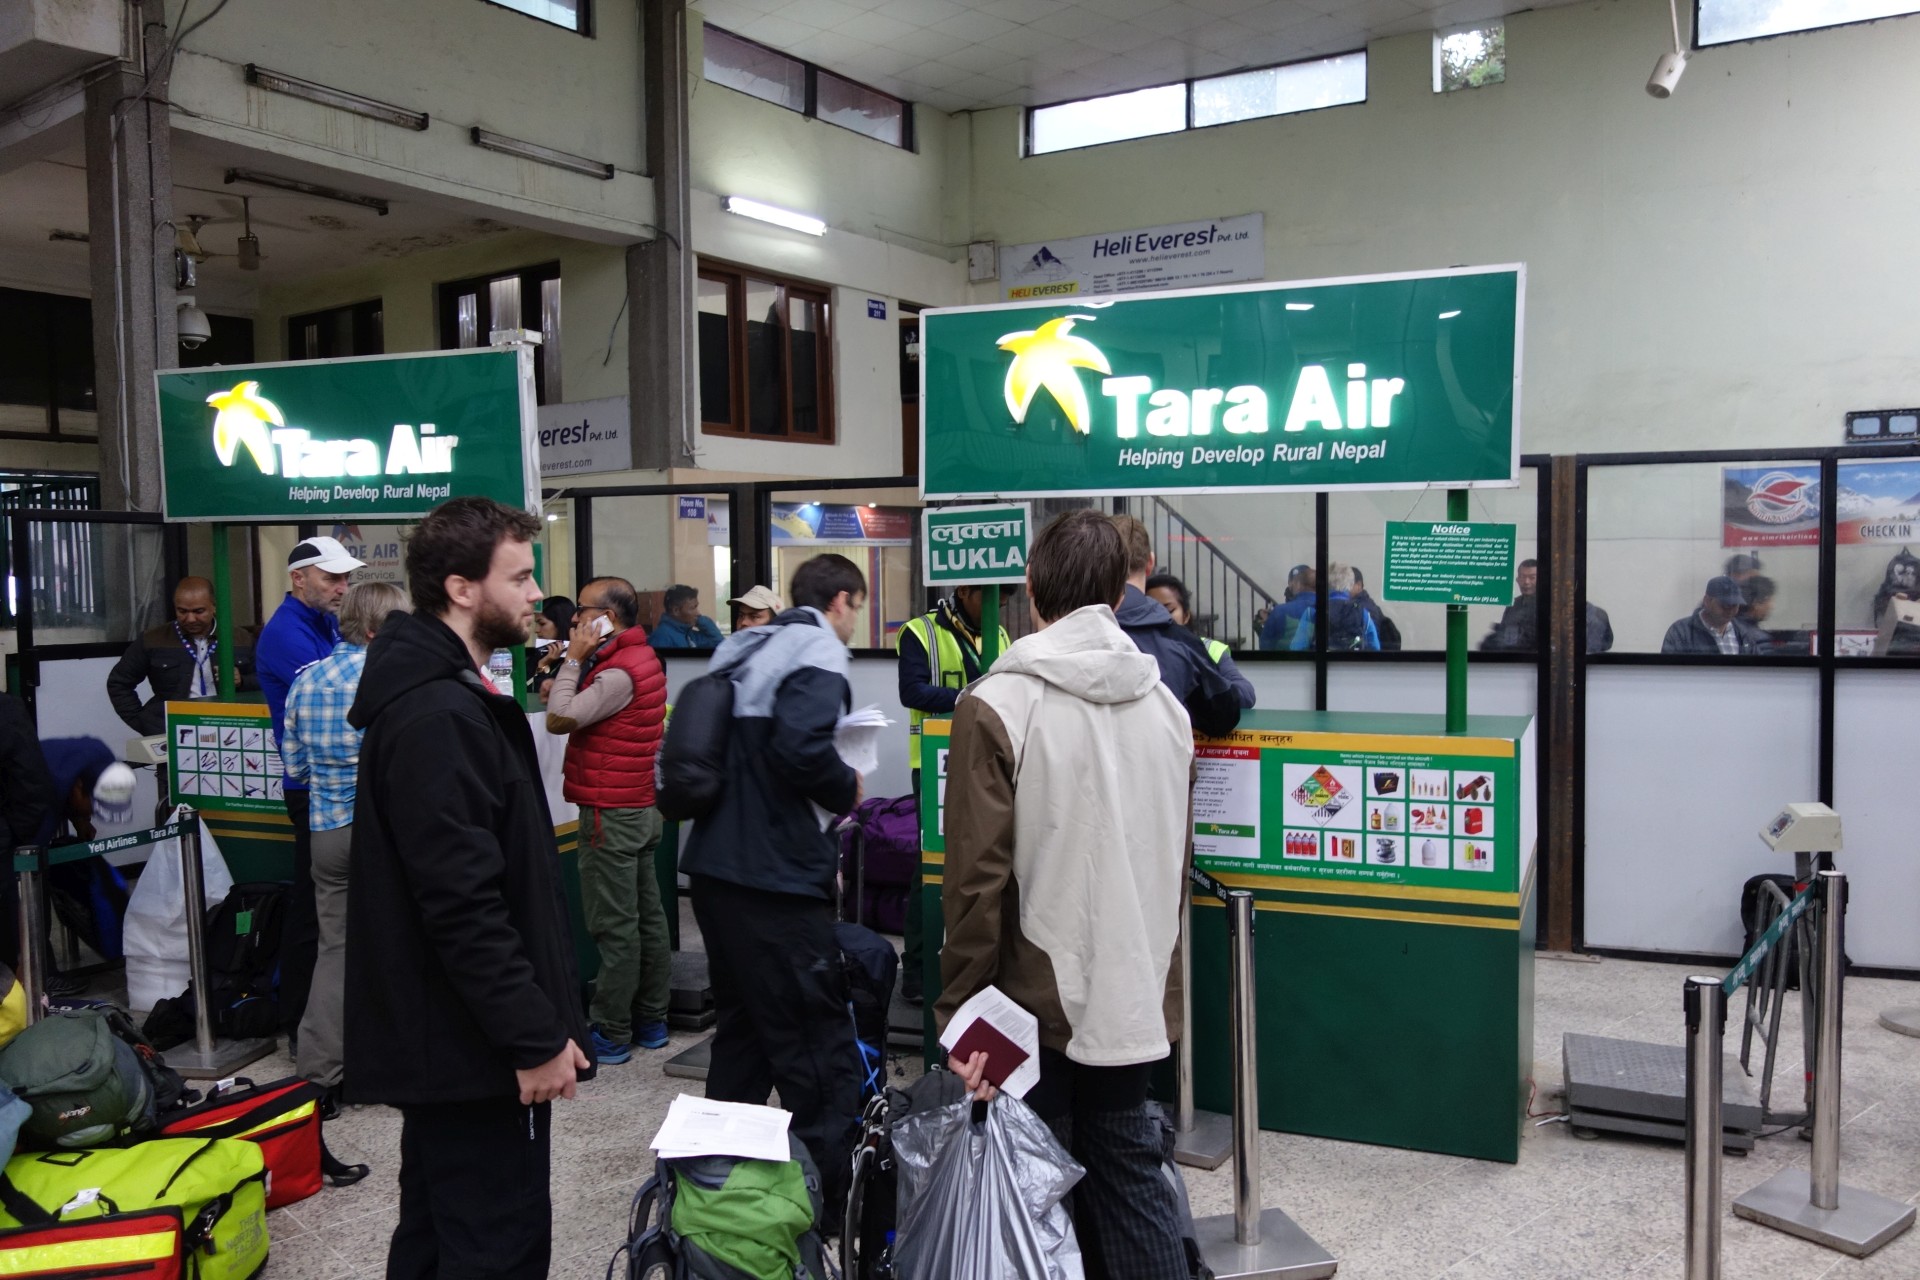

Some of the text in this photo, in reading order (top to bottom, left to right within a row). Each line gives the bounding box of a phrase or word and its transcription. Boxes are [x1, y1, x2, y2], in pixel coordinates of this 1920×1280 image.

[1217, 232, 1233, 243] Pvt.
[1234, 230, 1249, 241] Ltd.
[1129, 249, 1210, 265] www.helieverest.com
[1011, 283, 1076, 298] HELI EVEREST
[1102, 363, 1405, 438] Tara Air
[590, 431, 603, 441] Pvt.
[605, 430, 618, 440] Ltd.
[272, 423, 458, 479] Tara Air
[1118, 440, 1387, 469] Helping Develop Rural Nepal
[289, 483, 450, 503] Helping Develop Rural Nepal
[680, 499, 704, 508] Room No.
[931, 520, 1023, 545] लुक्ला
[1431, 524, 1471, 534] Notice
[1861, 525, 1911, 538] CHECK IN
[373, 543, 398, 558] AIR
[932, 546, 1025, 571] LUKLA
[356, 571, 394, 580] Service
[88, 826, 180, 854] Yeti Airlines Tara Air
[1216, 882, 1226, 900] Tara
